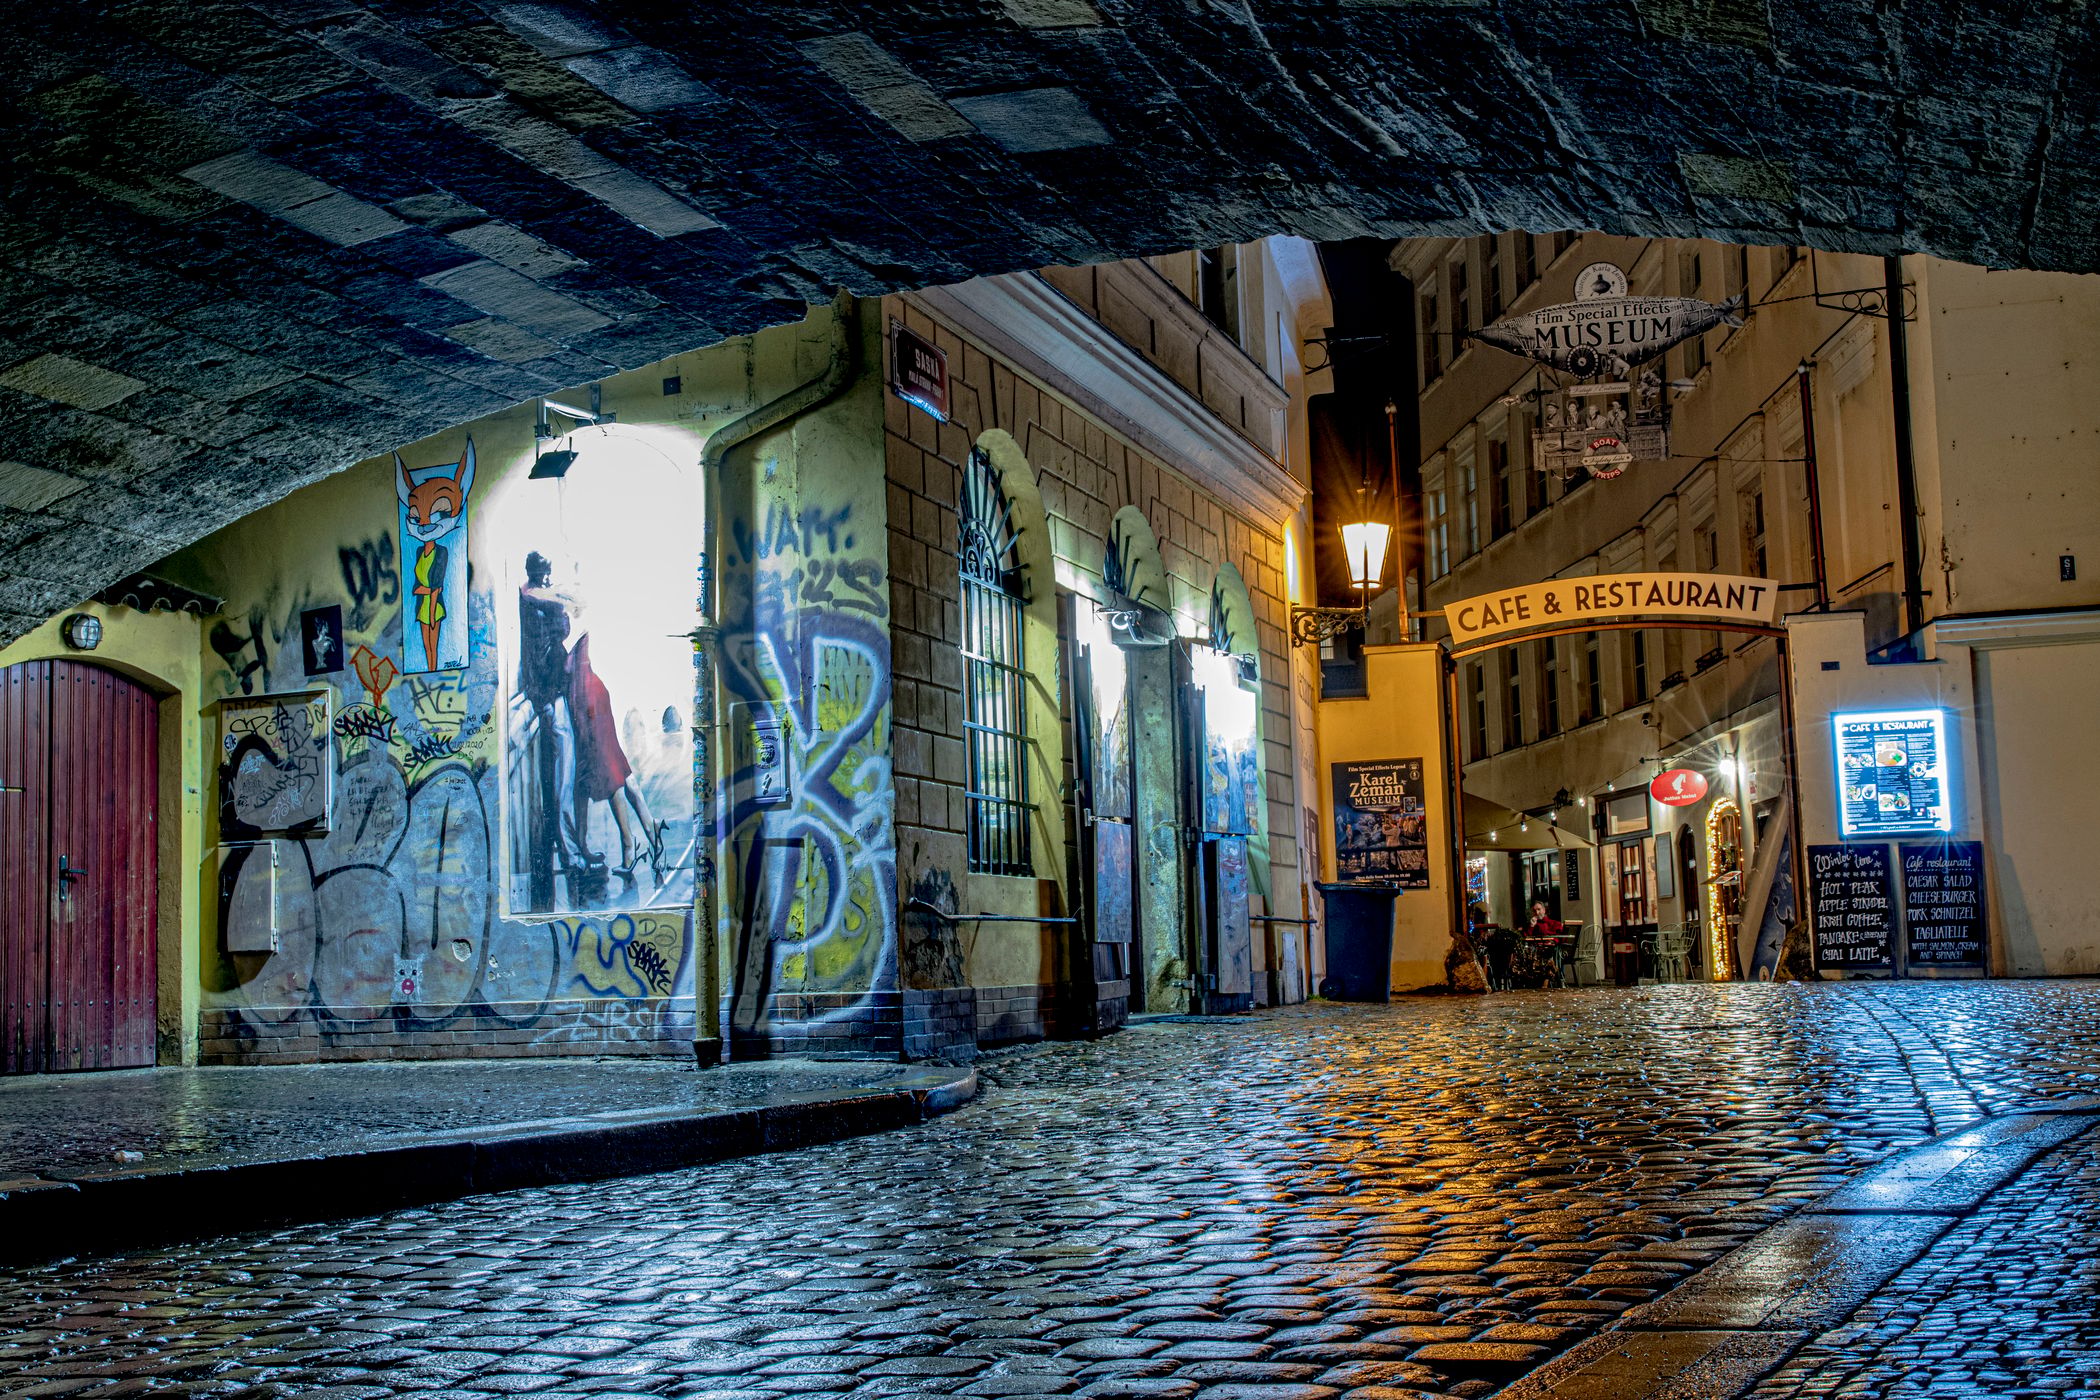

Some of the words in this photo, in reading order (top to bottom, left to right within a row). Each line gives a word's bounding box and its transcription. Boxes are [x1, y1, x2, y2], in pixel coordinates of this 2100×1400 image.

[1535, 312, 1563, 325] Film
[1568, 307, 1618, 323] Special
[1623, 302, 1670, 318] Effects
[1534, 316, 1672, 350] MUSEUM
[1593, 438, 1616, 448] BOAT
[1596, 469, 1620, 479] TRIPS
[1458, 594, 1531, 632] CAFE
[1544, 592, 1562, 614] &
[1574, 580, 1766, 612] RESTAURANT
[1850, 724, 1870, 733] CAFE
[1874, 723, 1880, 732] &
[1882, 720, 1928, 731] RESTAURANT
[1360, 772, 1398, 786] Karel
[1350, 782, 1406, 798] Zeman
[1355, 796, 1400, 806] MUSEUM
[1926, 856, 1972, 868] restaurant
[1908, 875, 1938, 888] CAESAR
[1944, 875, 1972, 888] SALAD
[1820, 882, 1844, 898] HOT
[1849, 881, 1880, 894] PEAR
[1909, 890, 1976, 904] CHEESEBURGER
[1818, 898, 1849, 913] APPLE
[1818, 914, 1844, 928] IRISH
[1847, 912, 1882, 926] COFFEE
[1907, 908, 1928, 922] PORK
[1930, 906, 1976, 920] SCHNITZEL
[1818, 930, 1860, 946] PANCAKE
[1914, 926, 1968, 940] TAGLIATELLE
[1912, 942, 1928, 950] WITH
[1822, 948, 1844, 961] CHAI
[1850, 946, 1880, 960] LATTE
[1920, 951, 1933, 960] AND
